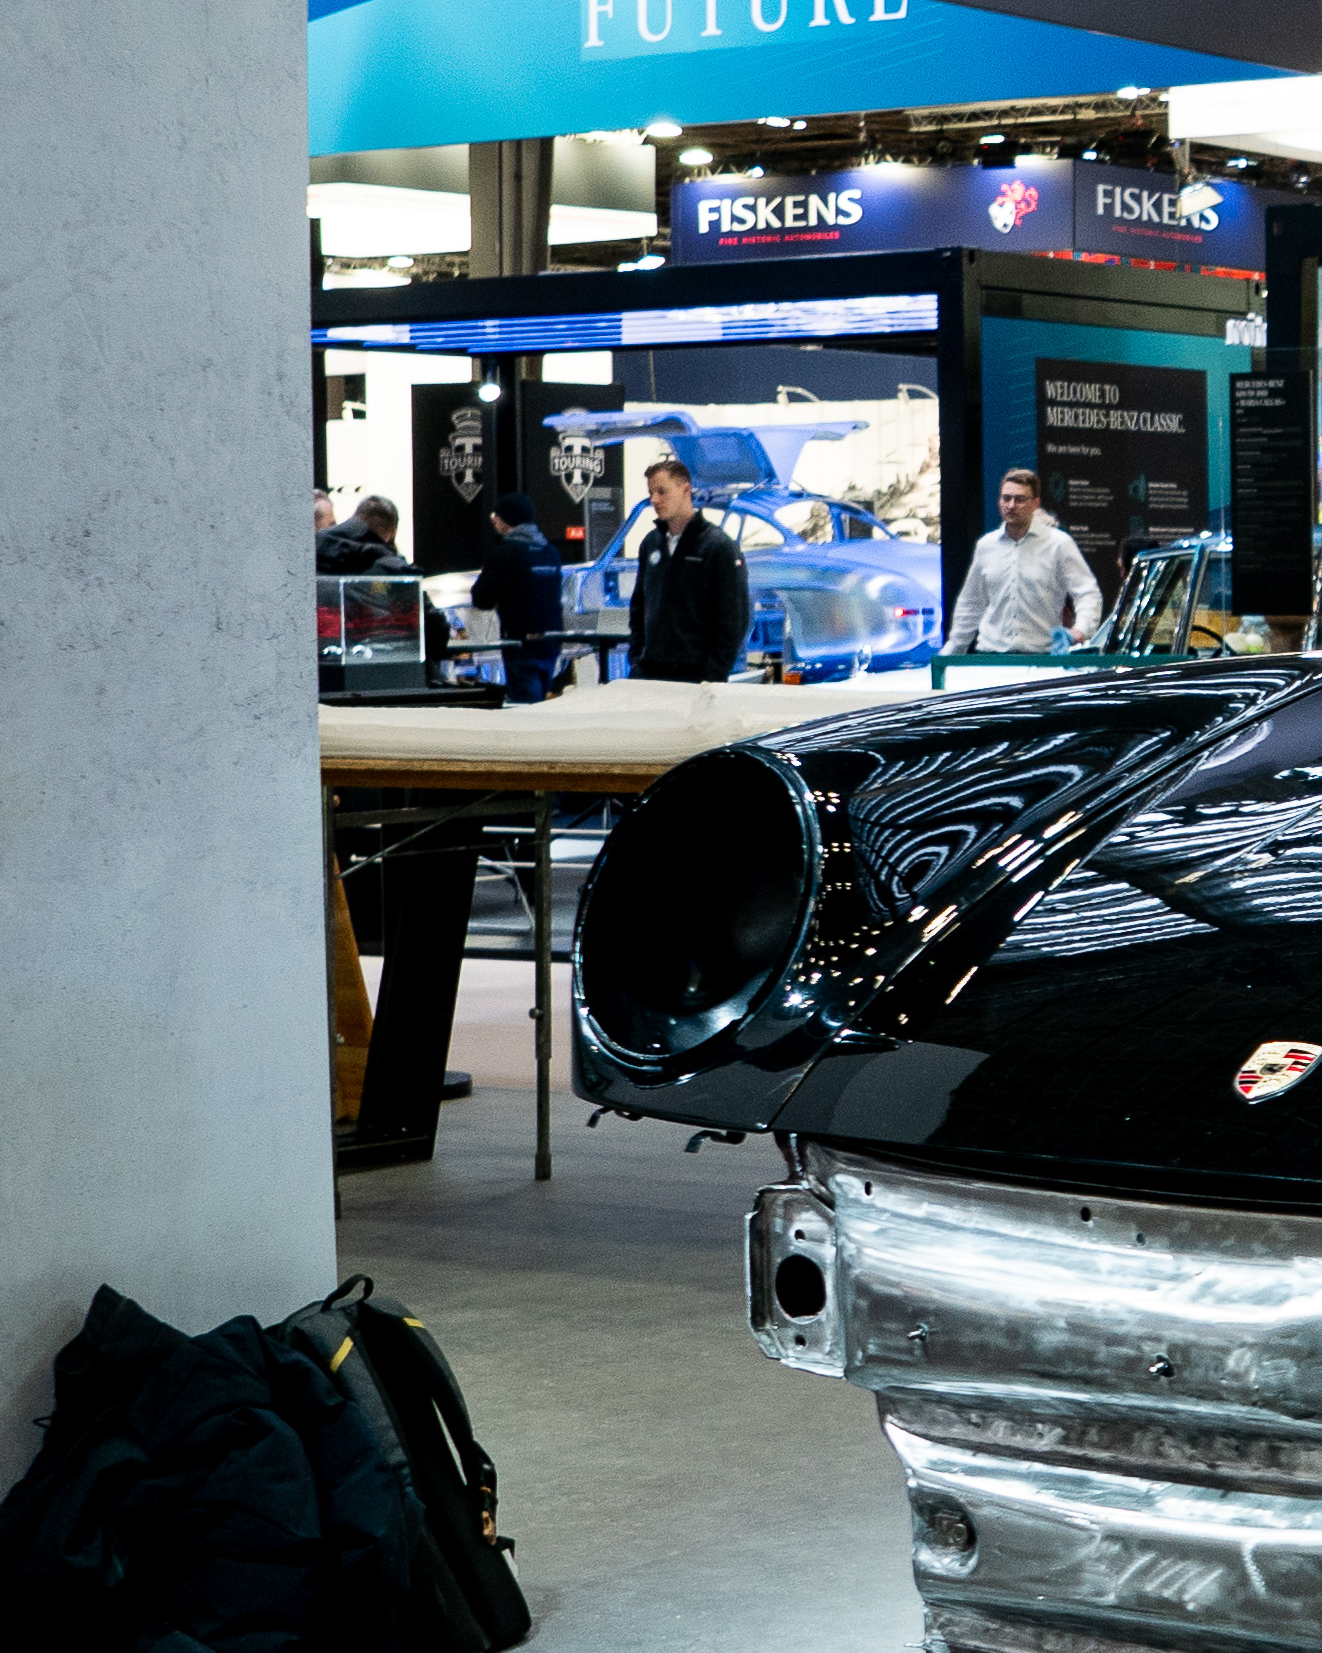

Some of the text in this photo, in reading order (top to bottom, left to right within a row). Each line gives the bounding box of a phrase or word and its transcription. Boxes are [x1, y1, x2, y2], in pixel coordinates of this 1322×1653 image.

[697, 188, 863, 235] FISKENS
[1045, 379, 1120, 404] WELCOME TO
[1046, 406, 1138, 430] MERCEDES-BENZ
[553, 456, 602, 473] TOURING
